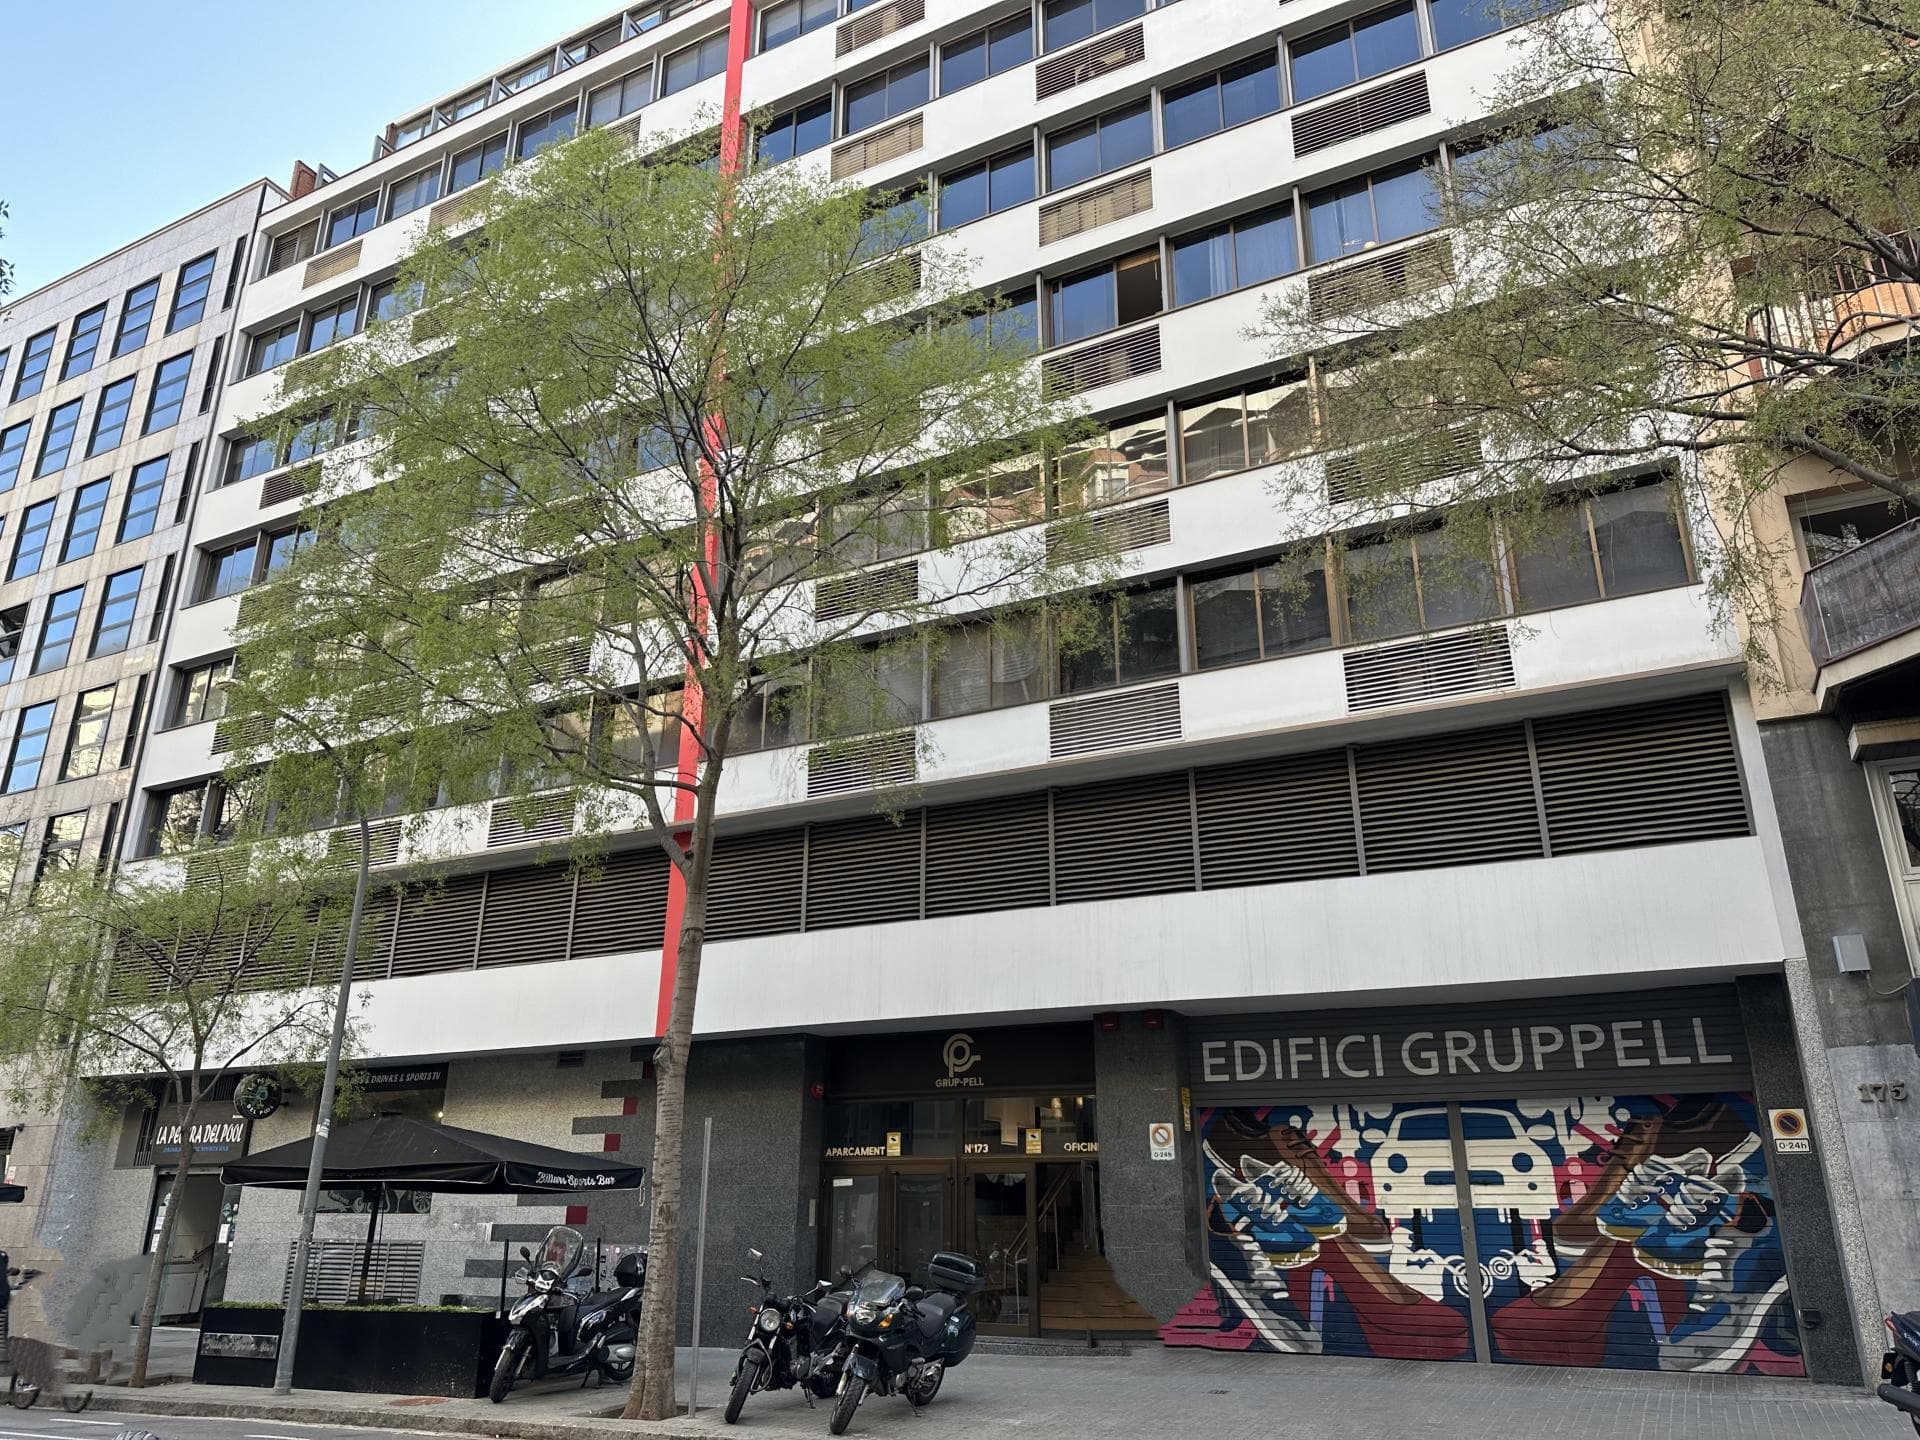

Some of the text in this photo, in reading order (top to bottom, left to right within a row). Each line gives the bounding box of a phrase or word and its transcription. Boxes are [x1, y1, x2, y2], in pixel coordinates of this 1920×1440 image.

[1202, 1017, 1732, 1082] EDIFICI GRUPPELL
[371, 1074, 398, 1084] DRINKS
[406, 1072, 432, 1082] SPORTS
[935, 1077, 984, 1088] GRUP-PELL
[1856, 1081, 1907, 1102] 175
[156, 1126, 168, 1145] LA
[202, 1123, 222, 1143] DEL
[220, 1123, 244, 1143] POOL
[825, 1146, 886, 1157] APARCAMENT
[1778, 1142, 1807, 1150] 0-24h
[566, 1173, 597, 1188] Sports
[596, 1174, 616, 1186] Bar
